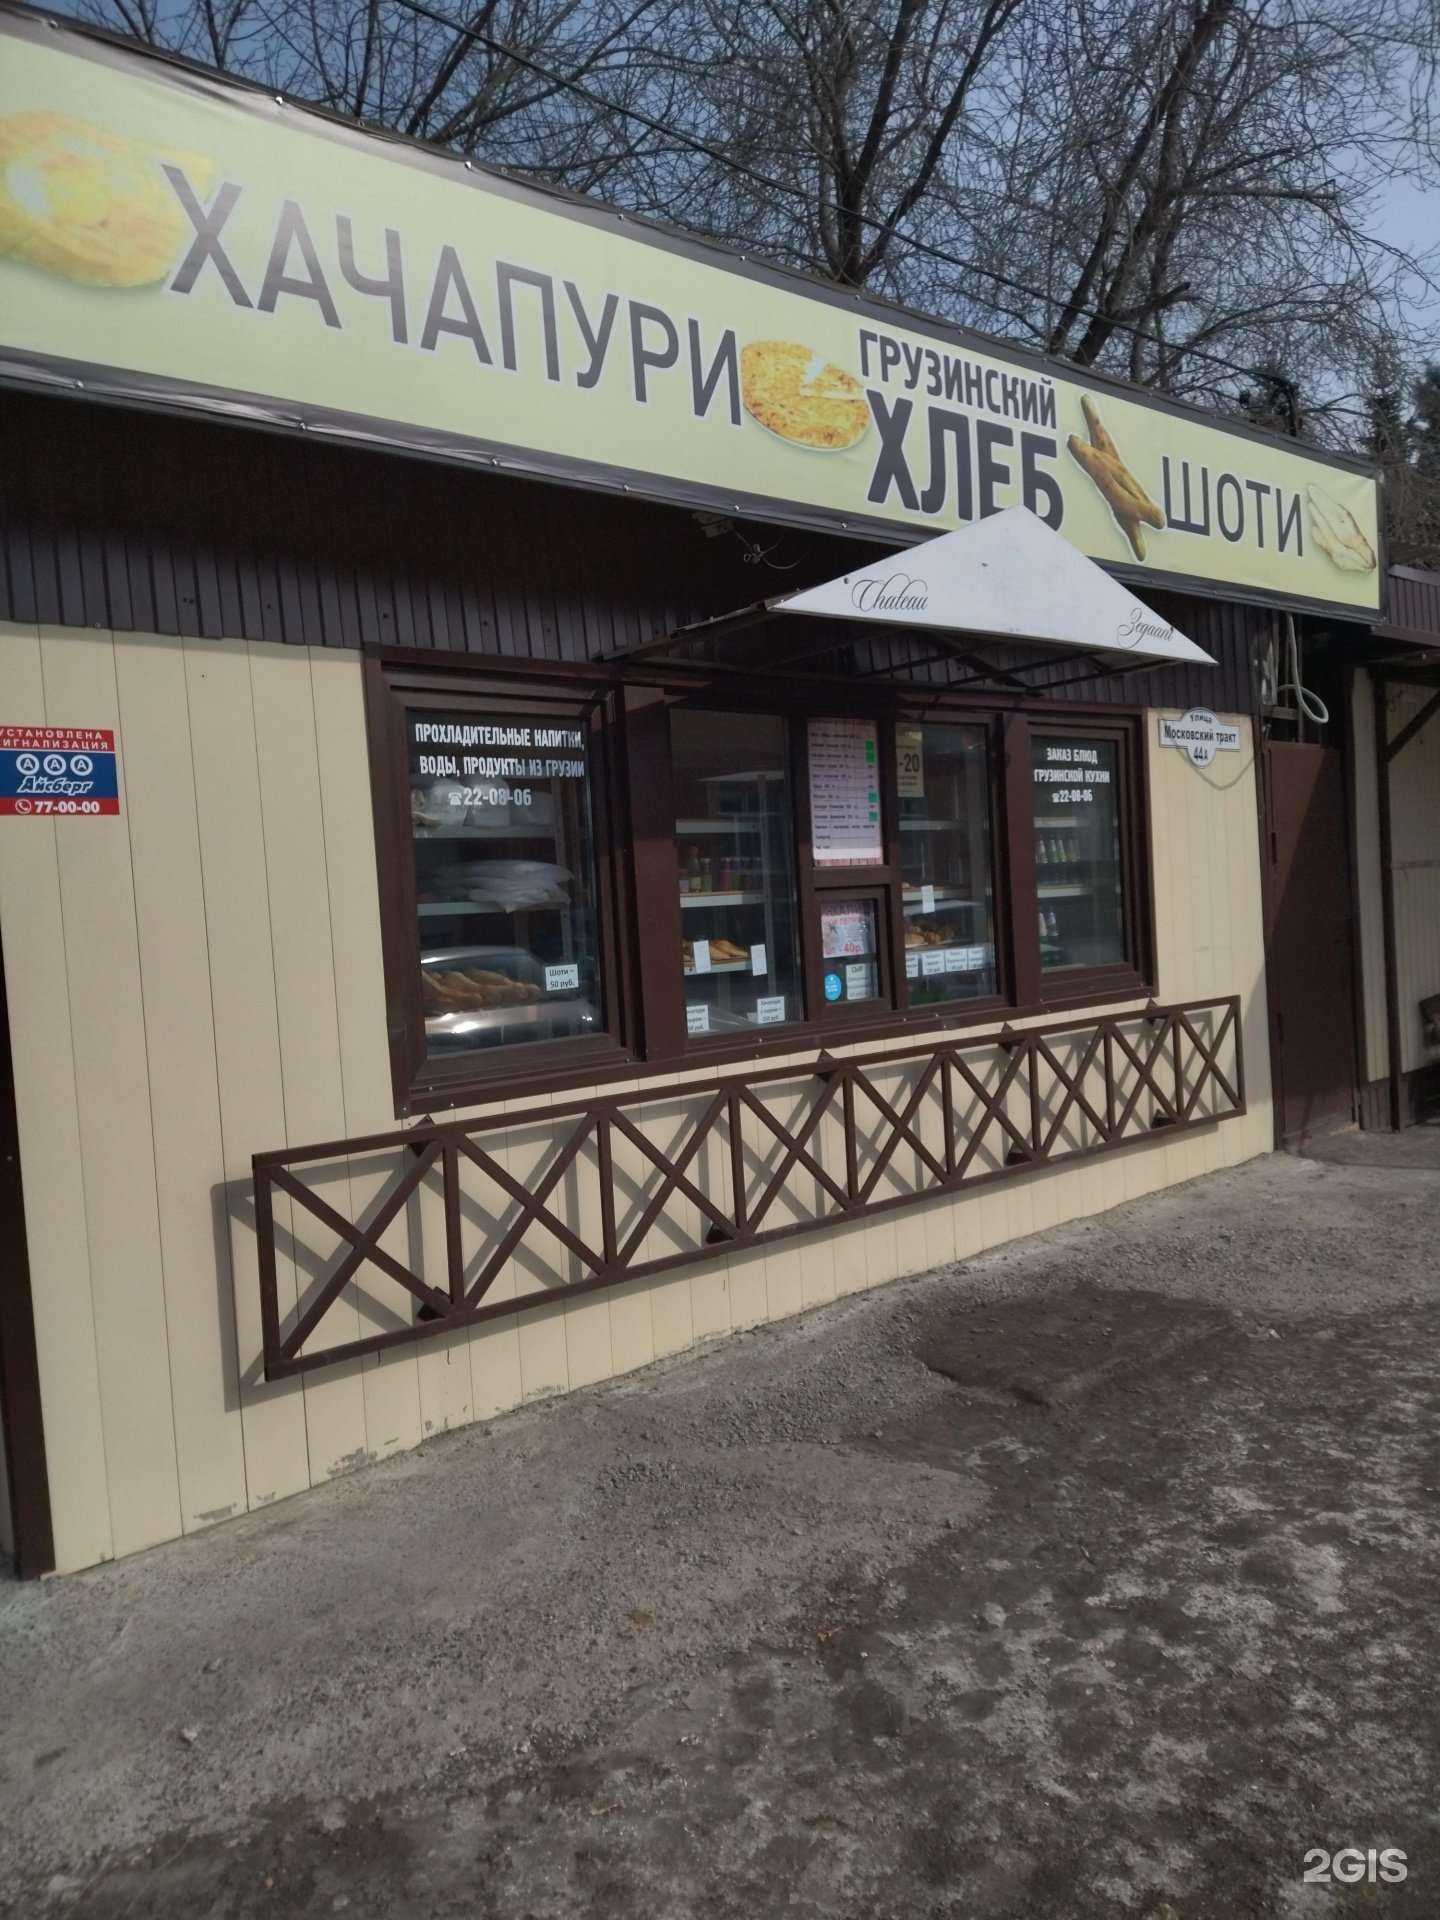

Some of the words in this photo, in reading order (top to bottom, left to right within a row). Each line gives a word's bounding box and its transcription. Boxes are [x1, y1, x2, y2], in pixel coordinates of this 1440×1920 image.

[162, 164, 743, 426] ХАЧАПУРИ
[859, 328, 1057, 430] ГРУЗИНСКИЙ
[866, 388, 1064, 531] ХЛЕБ
[1162, 456, 1304, 557] ШОТИ
[851, 572, 929, 613] Chateau
[0, 738, 109, 750] ИГНАЛИЗАЦИЯ
[415, 723, 531, 747] ПРОХЛАДИТЕЛЬНЫЕ
[1164, 725, 1214, 741] Московский
[1216, 732, 1236, 744] тракт
[419, 755, 460, 777] ВОДЫ,
[463, 756, 526, 777] ПРОДУКТЫ
[529, 760, 542, 775] ИЗ
[545, 760, 585, 778] ГРУЗИИ
[1046, 747, 1072, 761] ЗАКАЗ
[1073, 748, 1098, 765] БЛЮД
[16, 775, 94, 796] Айсберг
[34, 800, 100, 814] 77-00-00
